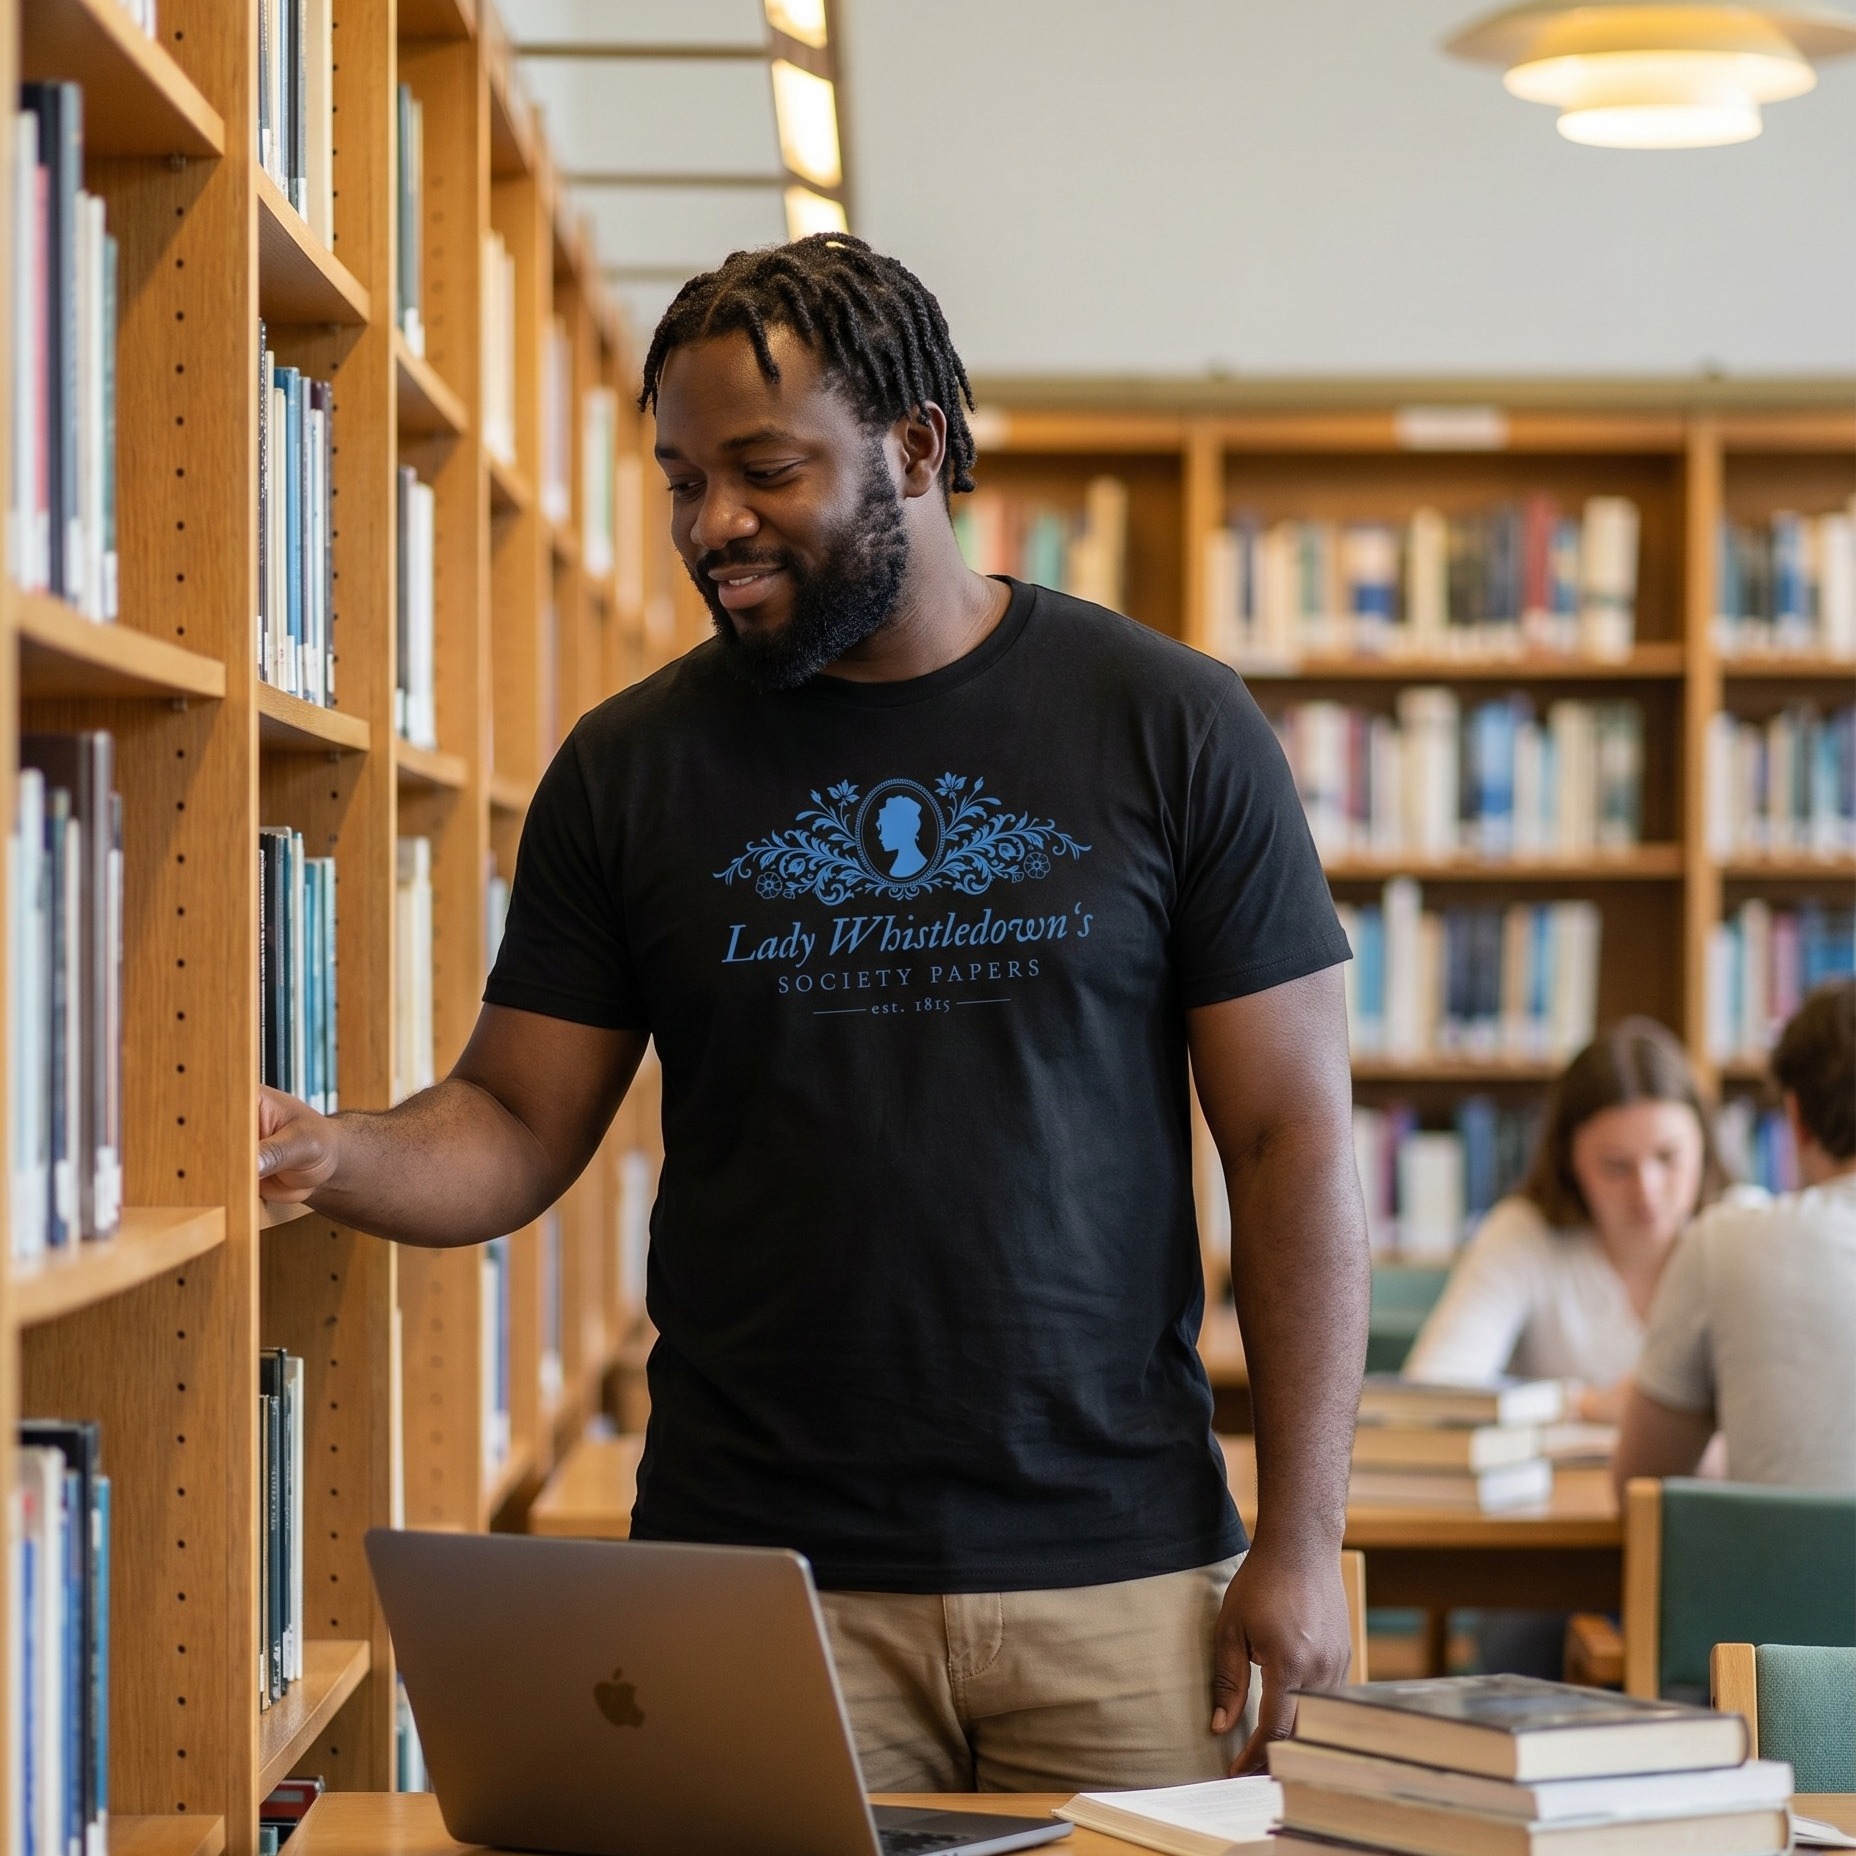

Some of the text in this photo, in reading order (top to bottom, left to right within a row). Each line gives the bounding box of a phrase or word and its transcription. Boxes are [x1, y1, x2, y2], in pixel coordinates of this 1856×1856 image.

[721, 901, 1095, 968] Lady Whistledown's
[777, 958, 1041, 994] SOCIETY PAPERS
[870, 997, 951, 1015] est. 1815
